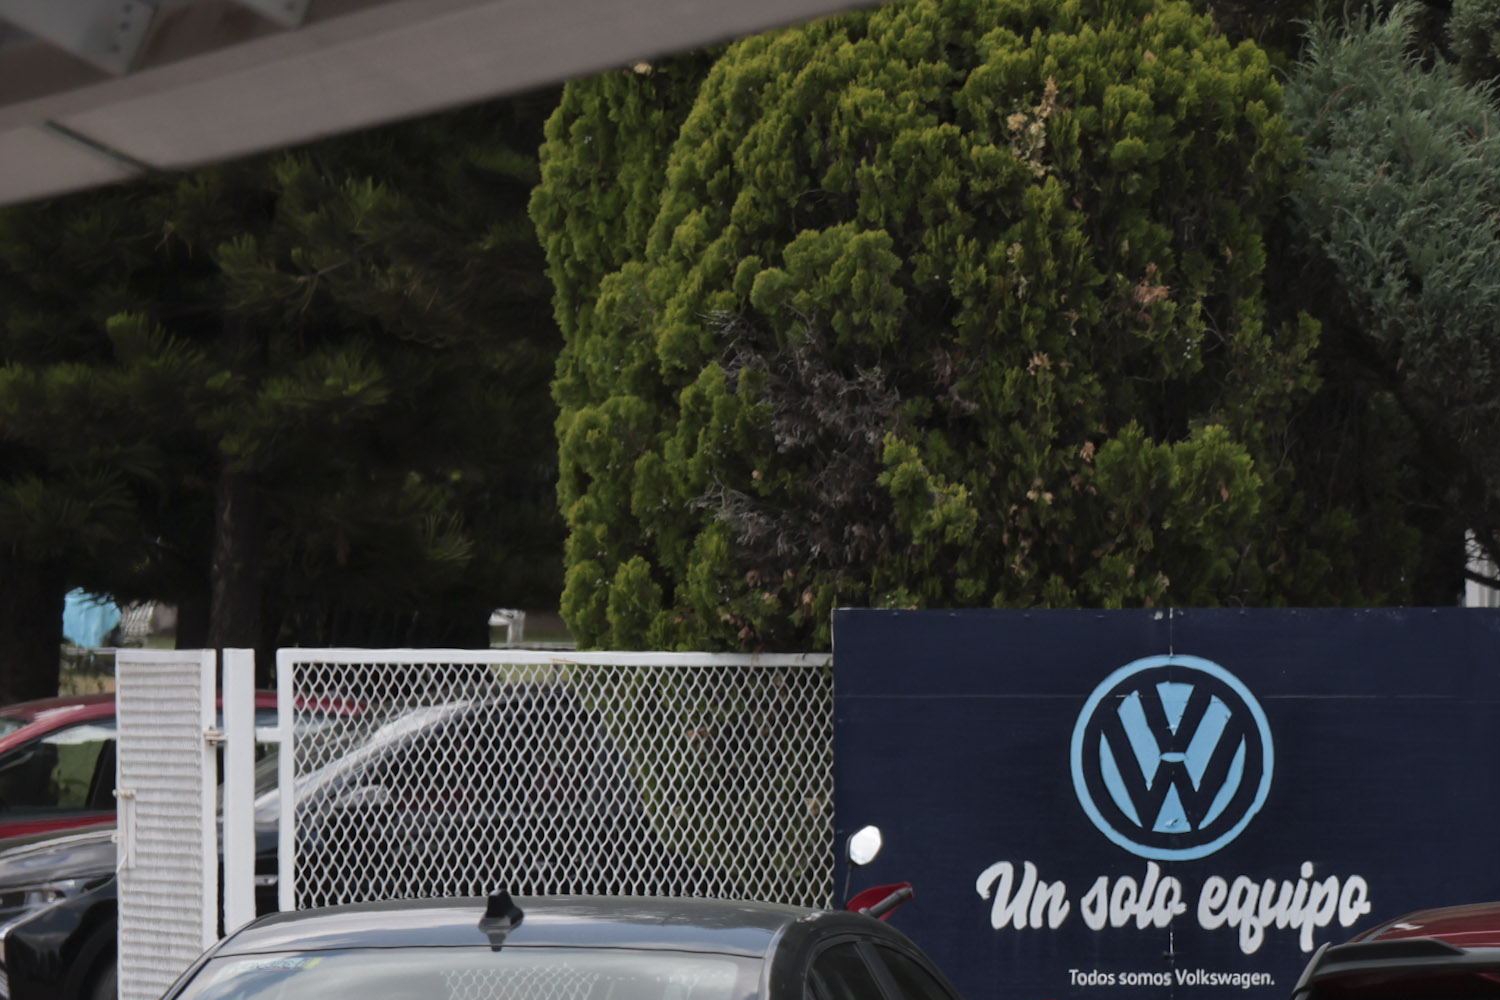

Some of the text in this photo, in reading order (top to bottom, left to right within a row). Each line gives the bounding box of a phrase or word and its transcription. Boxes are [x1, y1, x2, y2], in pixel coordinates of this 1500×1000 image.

[976, 860, 1371, 954] Un solo equipo
[1068, 969, 1275, 989] Todos somos Volkswagen.
